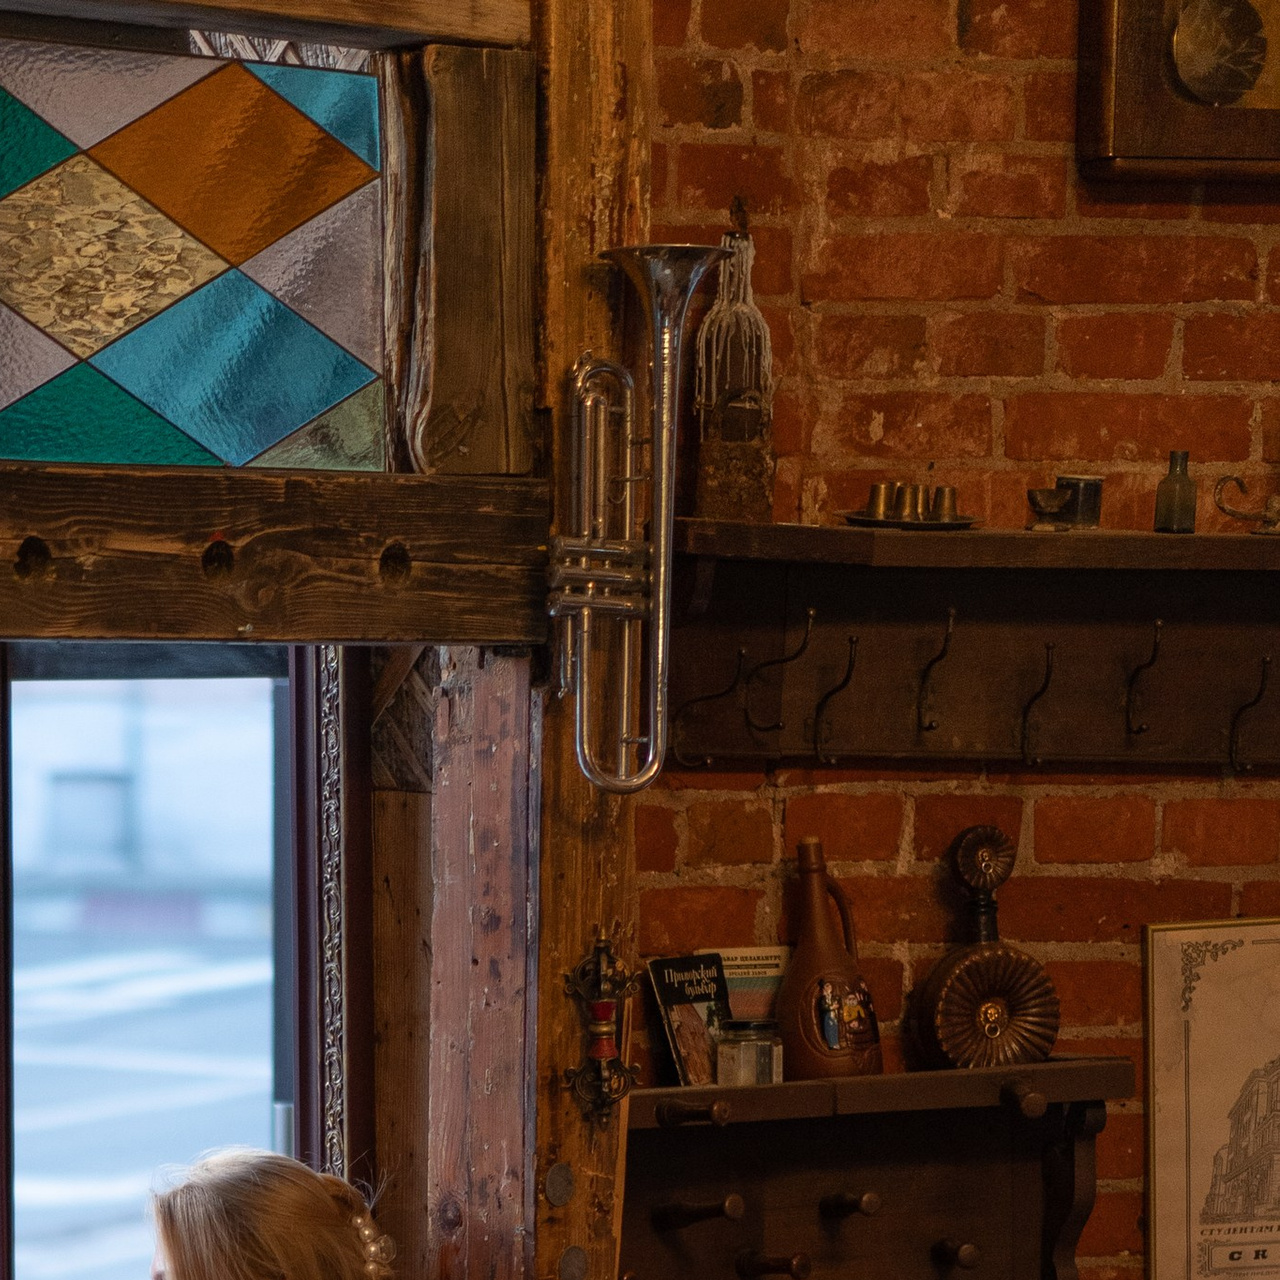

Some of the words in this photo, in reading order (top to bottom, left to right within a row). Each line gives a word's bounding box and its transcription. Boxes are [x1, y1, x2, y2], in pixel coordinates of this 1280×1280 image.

[664, 964, 717, 987] Приморский
[683, 980, 717, 999] бульвар
[1200, 1226, 1273, 1236] СТУДЕНТАМ
